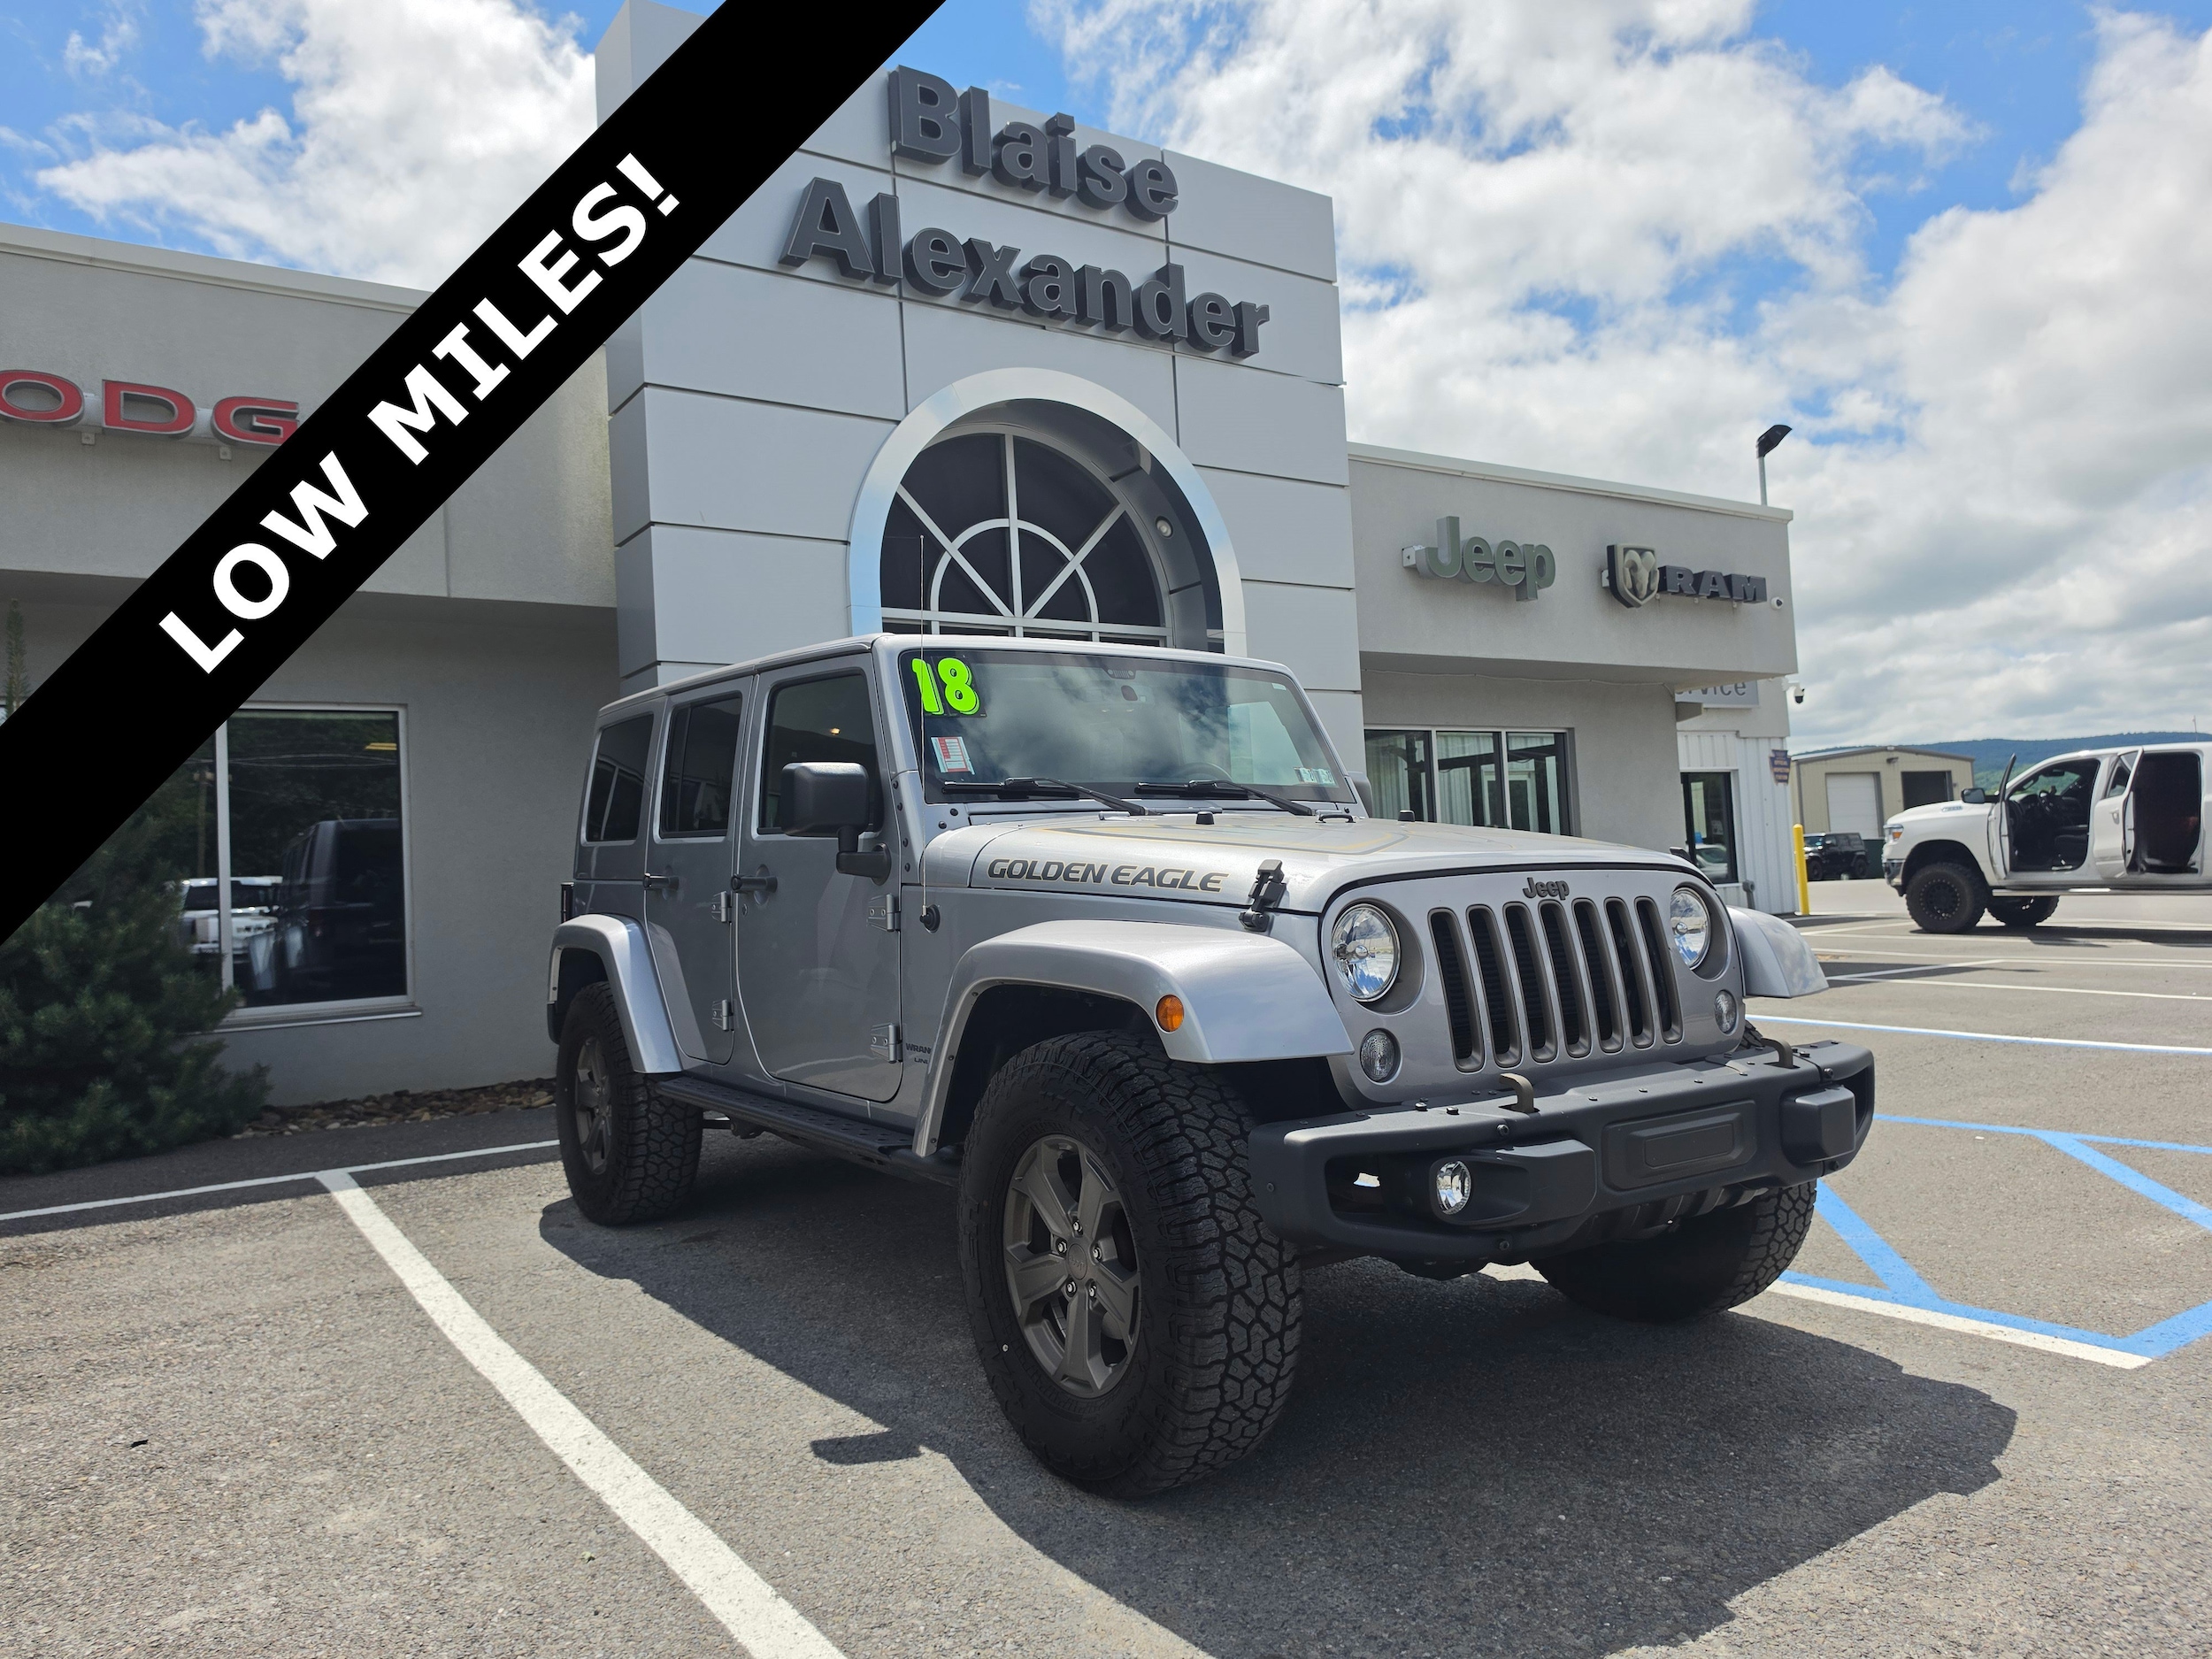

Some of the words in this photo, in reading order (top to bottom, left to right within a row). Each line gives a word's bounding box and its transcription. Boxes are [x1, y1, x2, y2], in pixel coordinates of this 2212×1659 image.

[888, 65, 1179, 222] Blaise
[779, 177, 1270, 357] Alexander
[1416, 516, 1555, 602] Jeep
[1658, 565, 1768, 603] RAM
[912, 658, 980, 715] 18
[987, 858, 1109, 884] GOLDEN
[1110, 864, 1229, 893] EAGLE
[1522, 877, 1570, 901] Jeep
